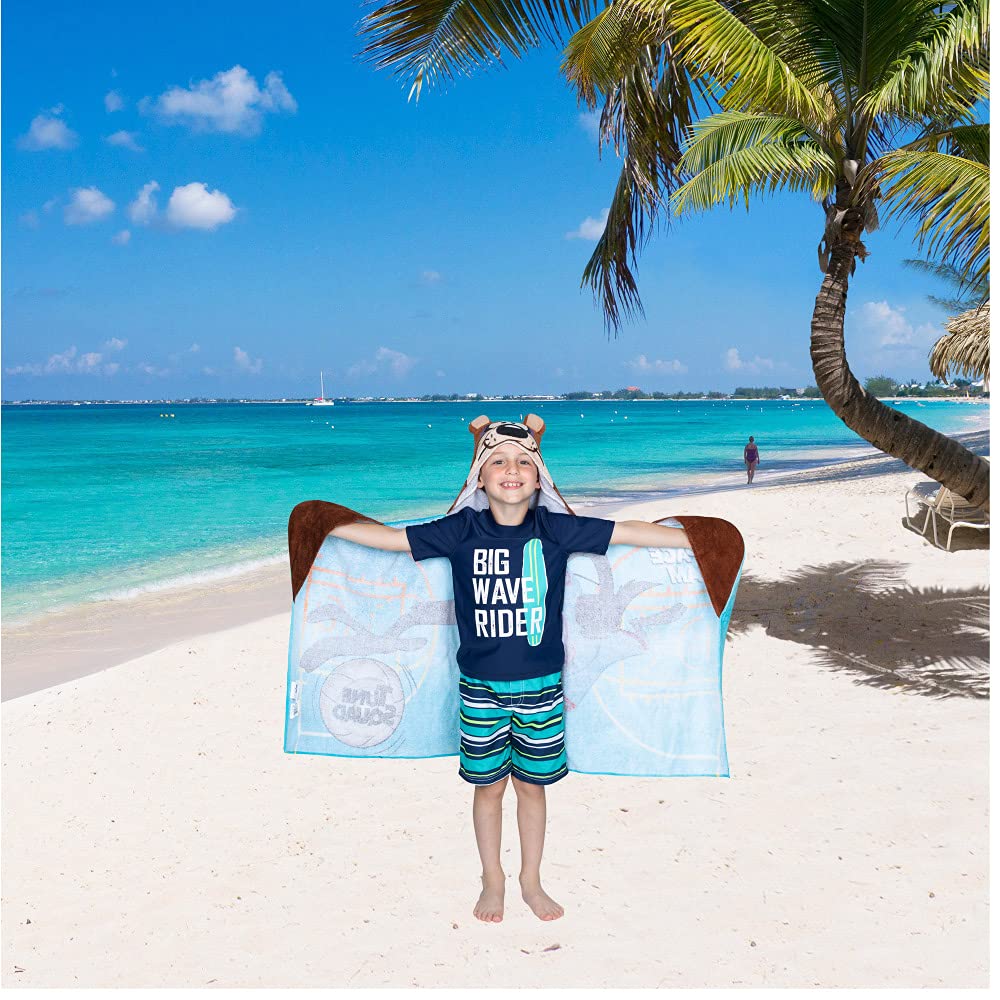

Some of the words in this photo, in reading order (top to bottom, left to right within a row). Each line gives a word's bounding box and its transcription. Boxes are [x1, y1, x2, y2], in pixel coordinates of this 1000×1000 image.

[473, 548, 510, 575] BIG
[471, 577, 535, 605] WAVE
[474, 606, 543, 638] RIDER
